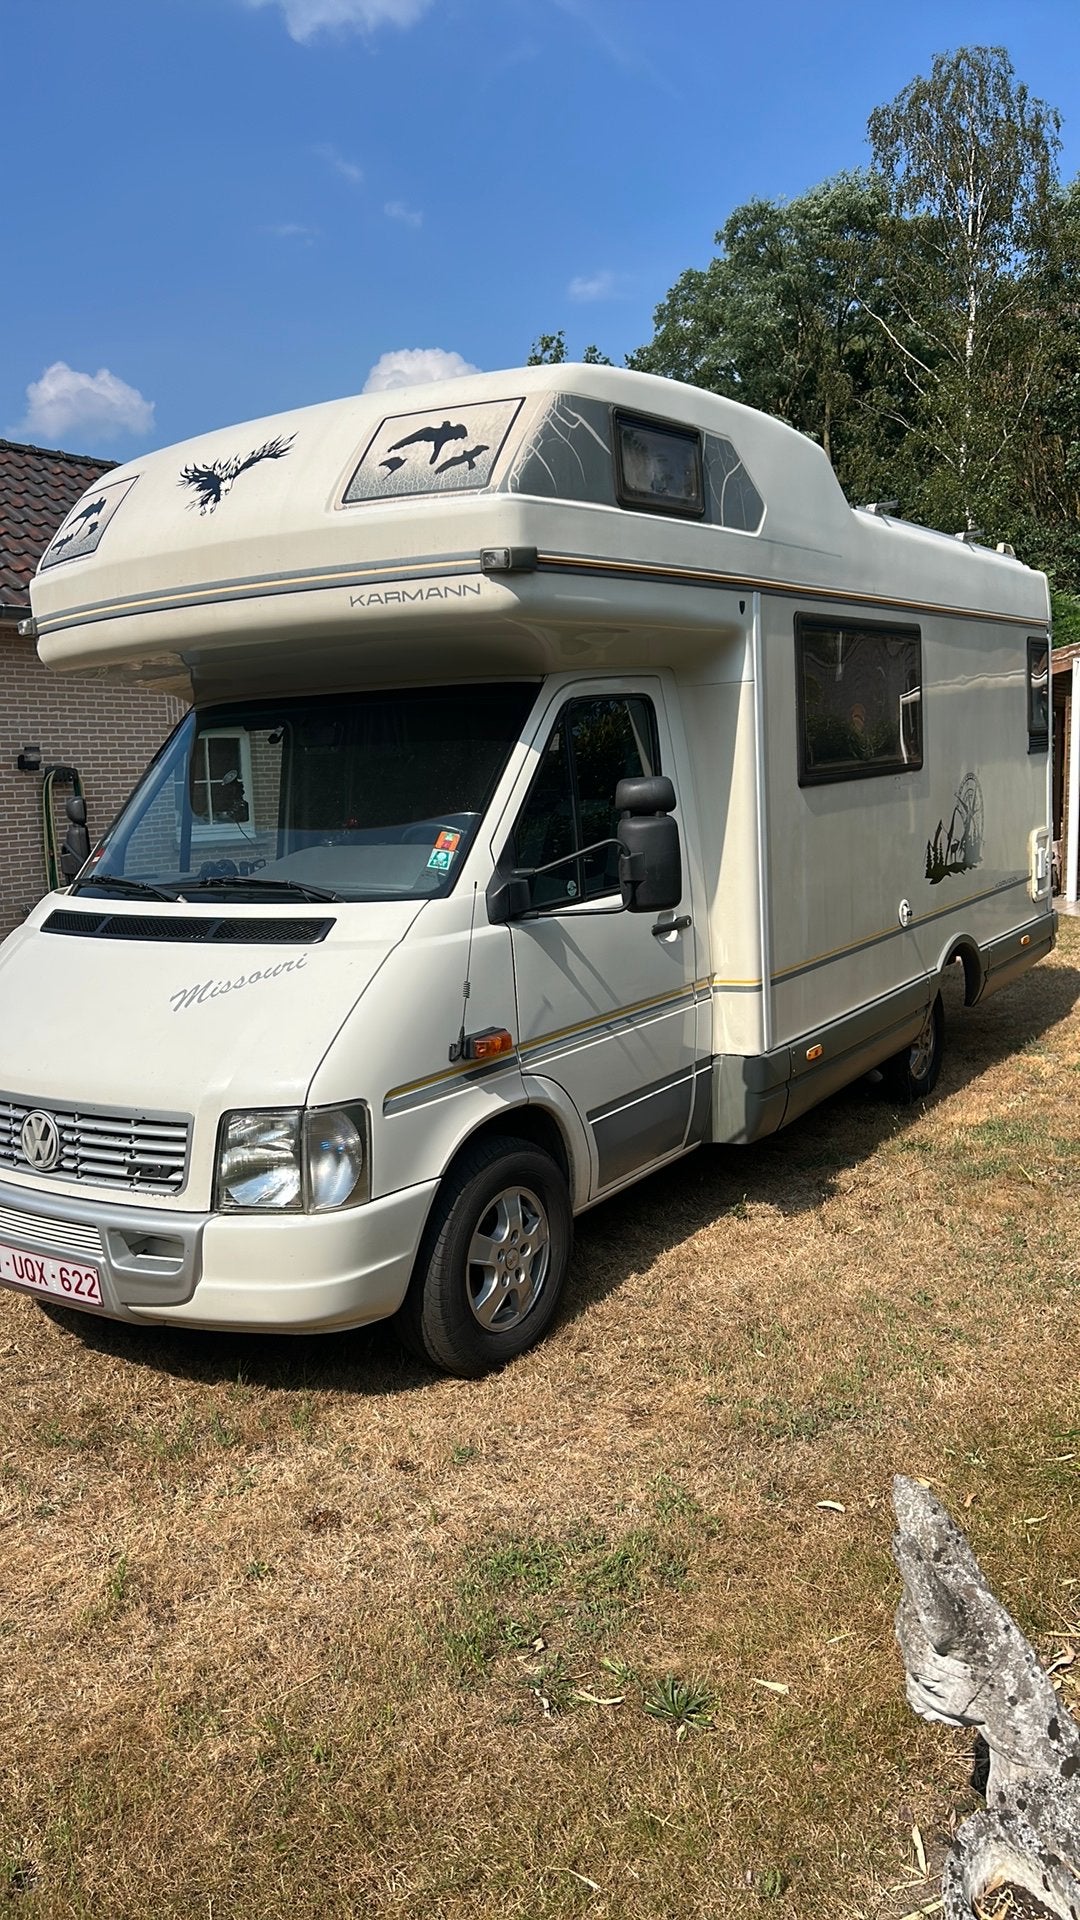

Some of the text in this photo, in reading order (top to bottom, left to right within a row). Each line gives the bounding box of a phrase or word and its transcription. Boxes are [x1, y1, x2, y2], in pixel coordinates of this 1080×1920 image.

[350, 583, 481, 607] KARMANN
[169, 953, 308, 1012] Missouri
[0, 1254, 99, 1299] -UQX-622
